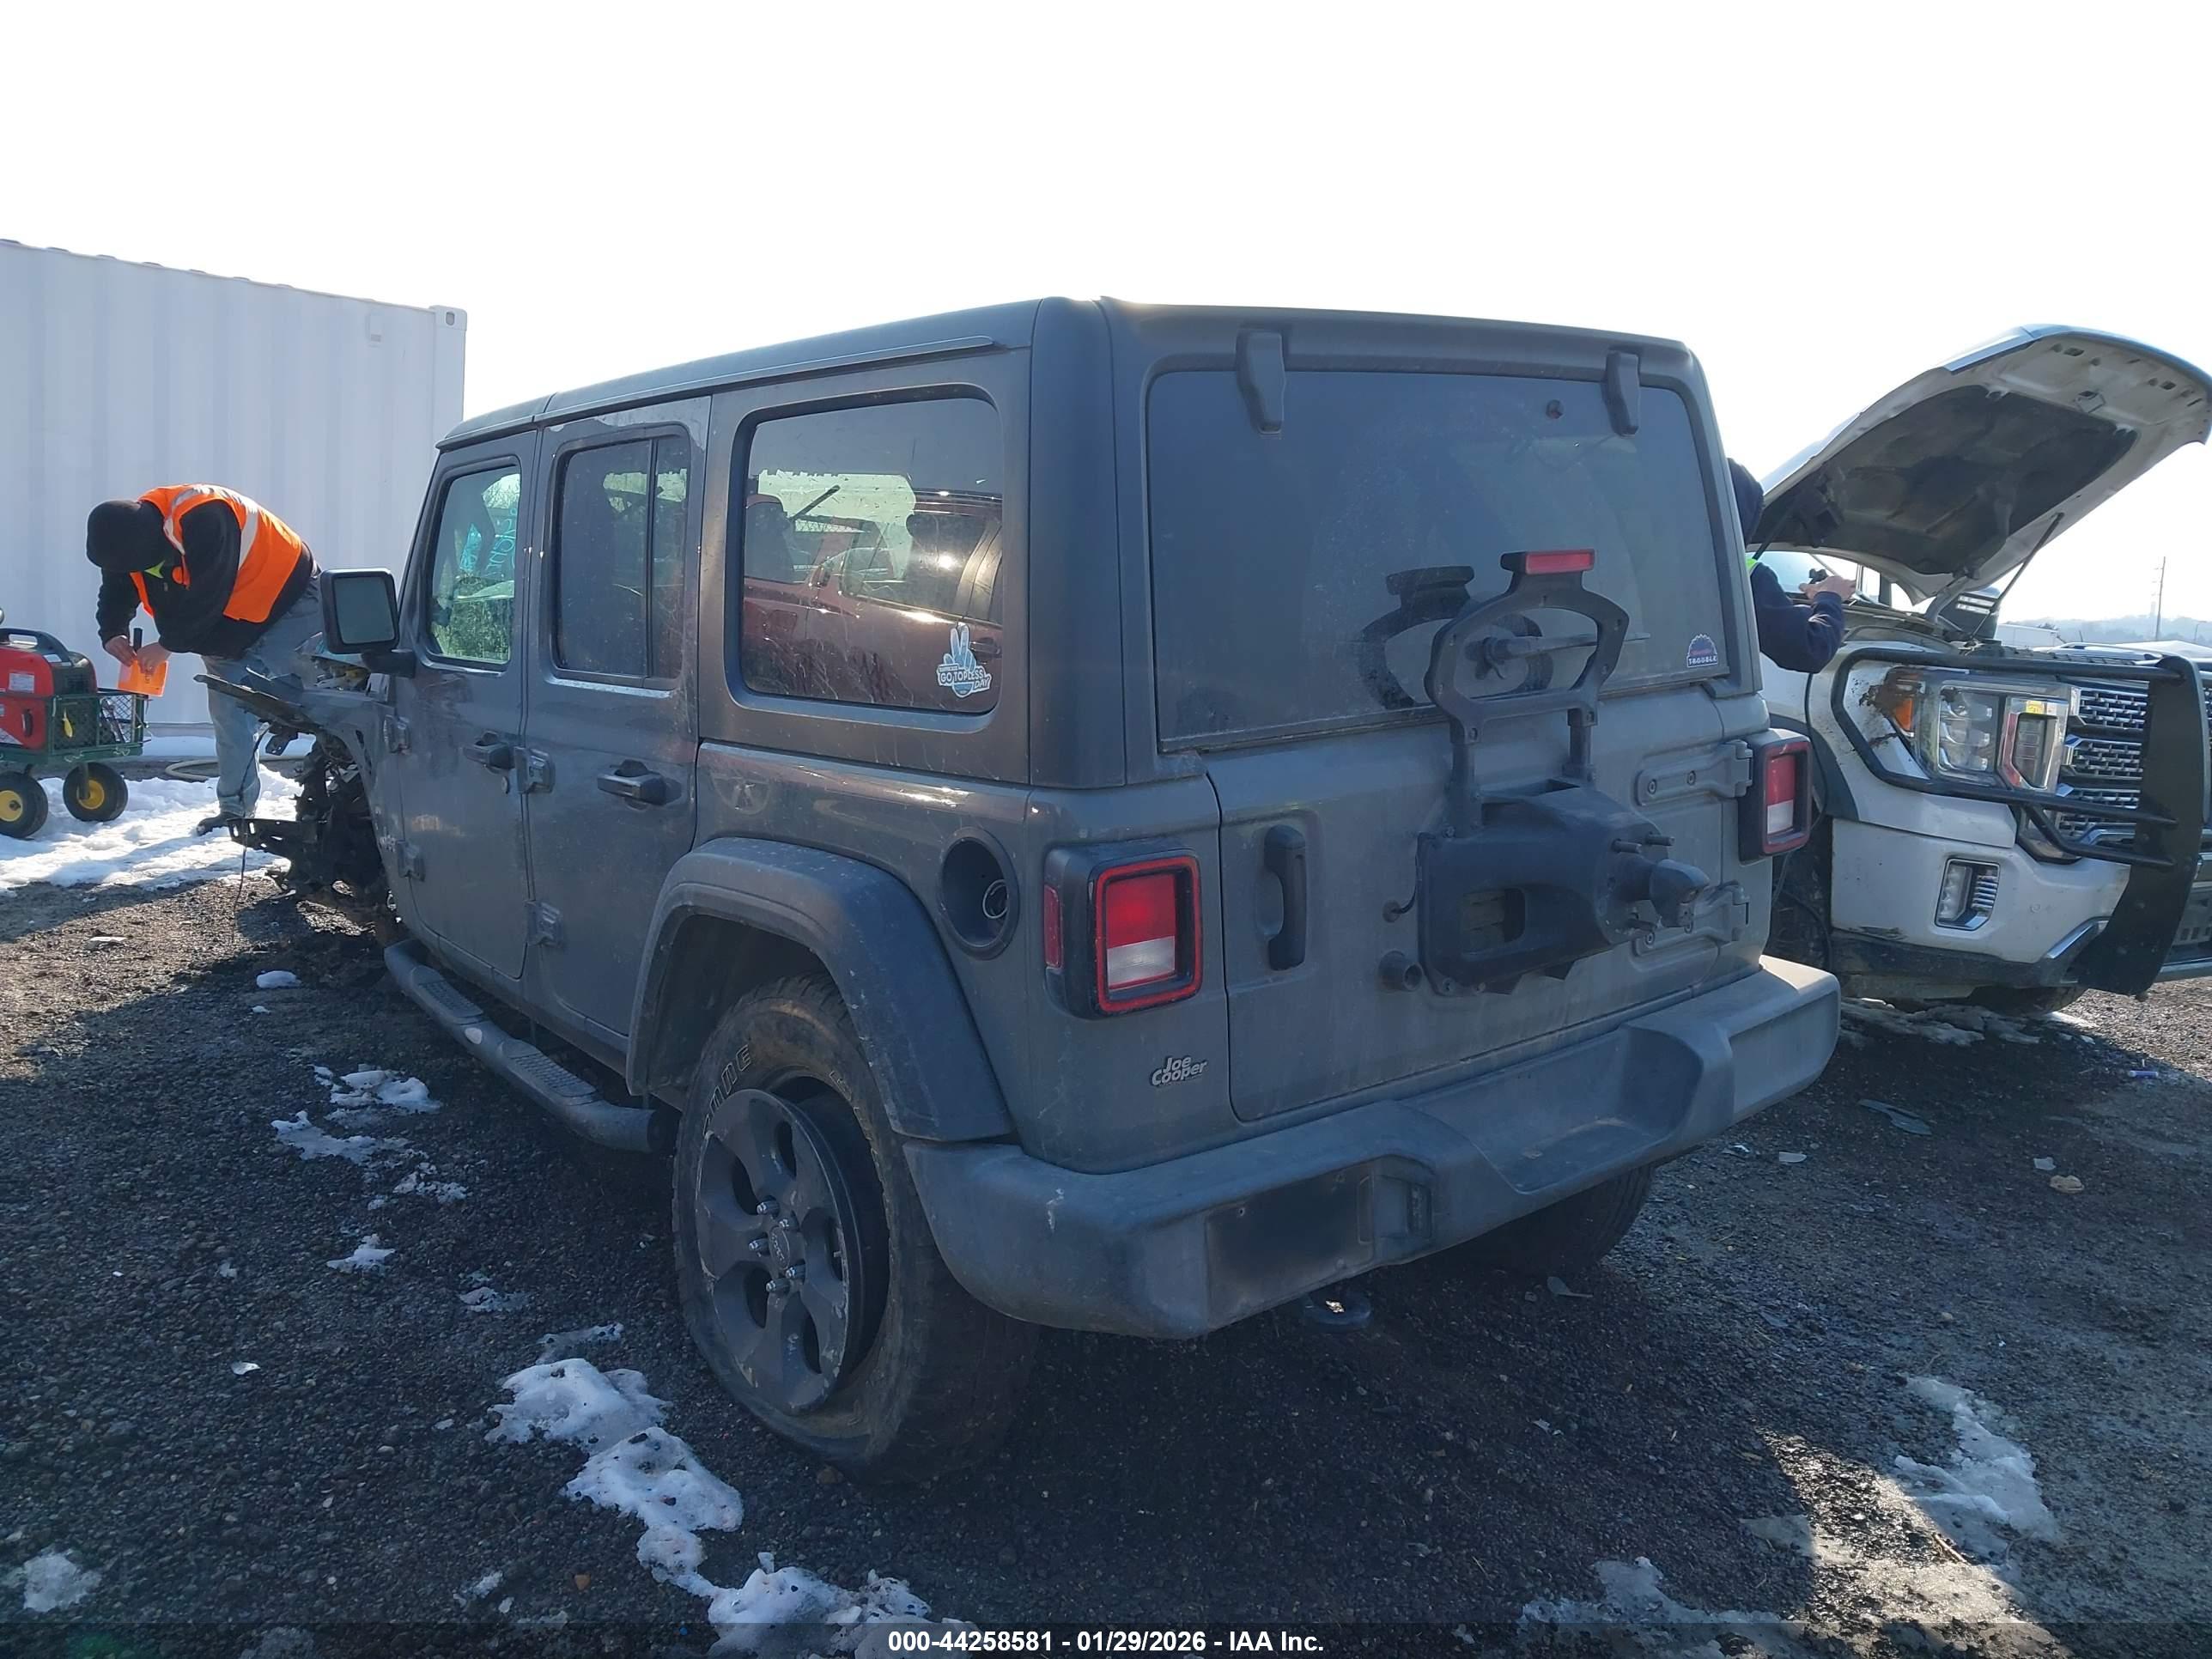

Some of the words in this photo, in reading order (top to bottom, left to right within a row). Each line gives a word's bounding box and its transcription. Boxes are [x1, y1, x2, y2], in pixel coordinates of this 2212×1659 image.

[940, 672, 952, 683] GO
[953, 668, 984, 682] TOPLESS
[975, 678, 990, 689] DAY
[1163, 1057, 1192, 1073] Joe
[1152, 1061, 1208, 1085] Cooper
